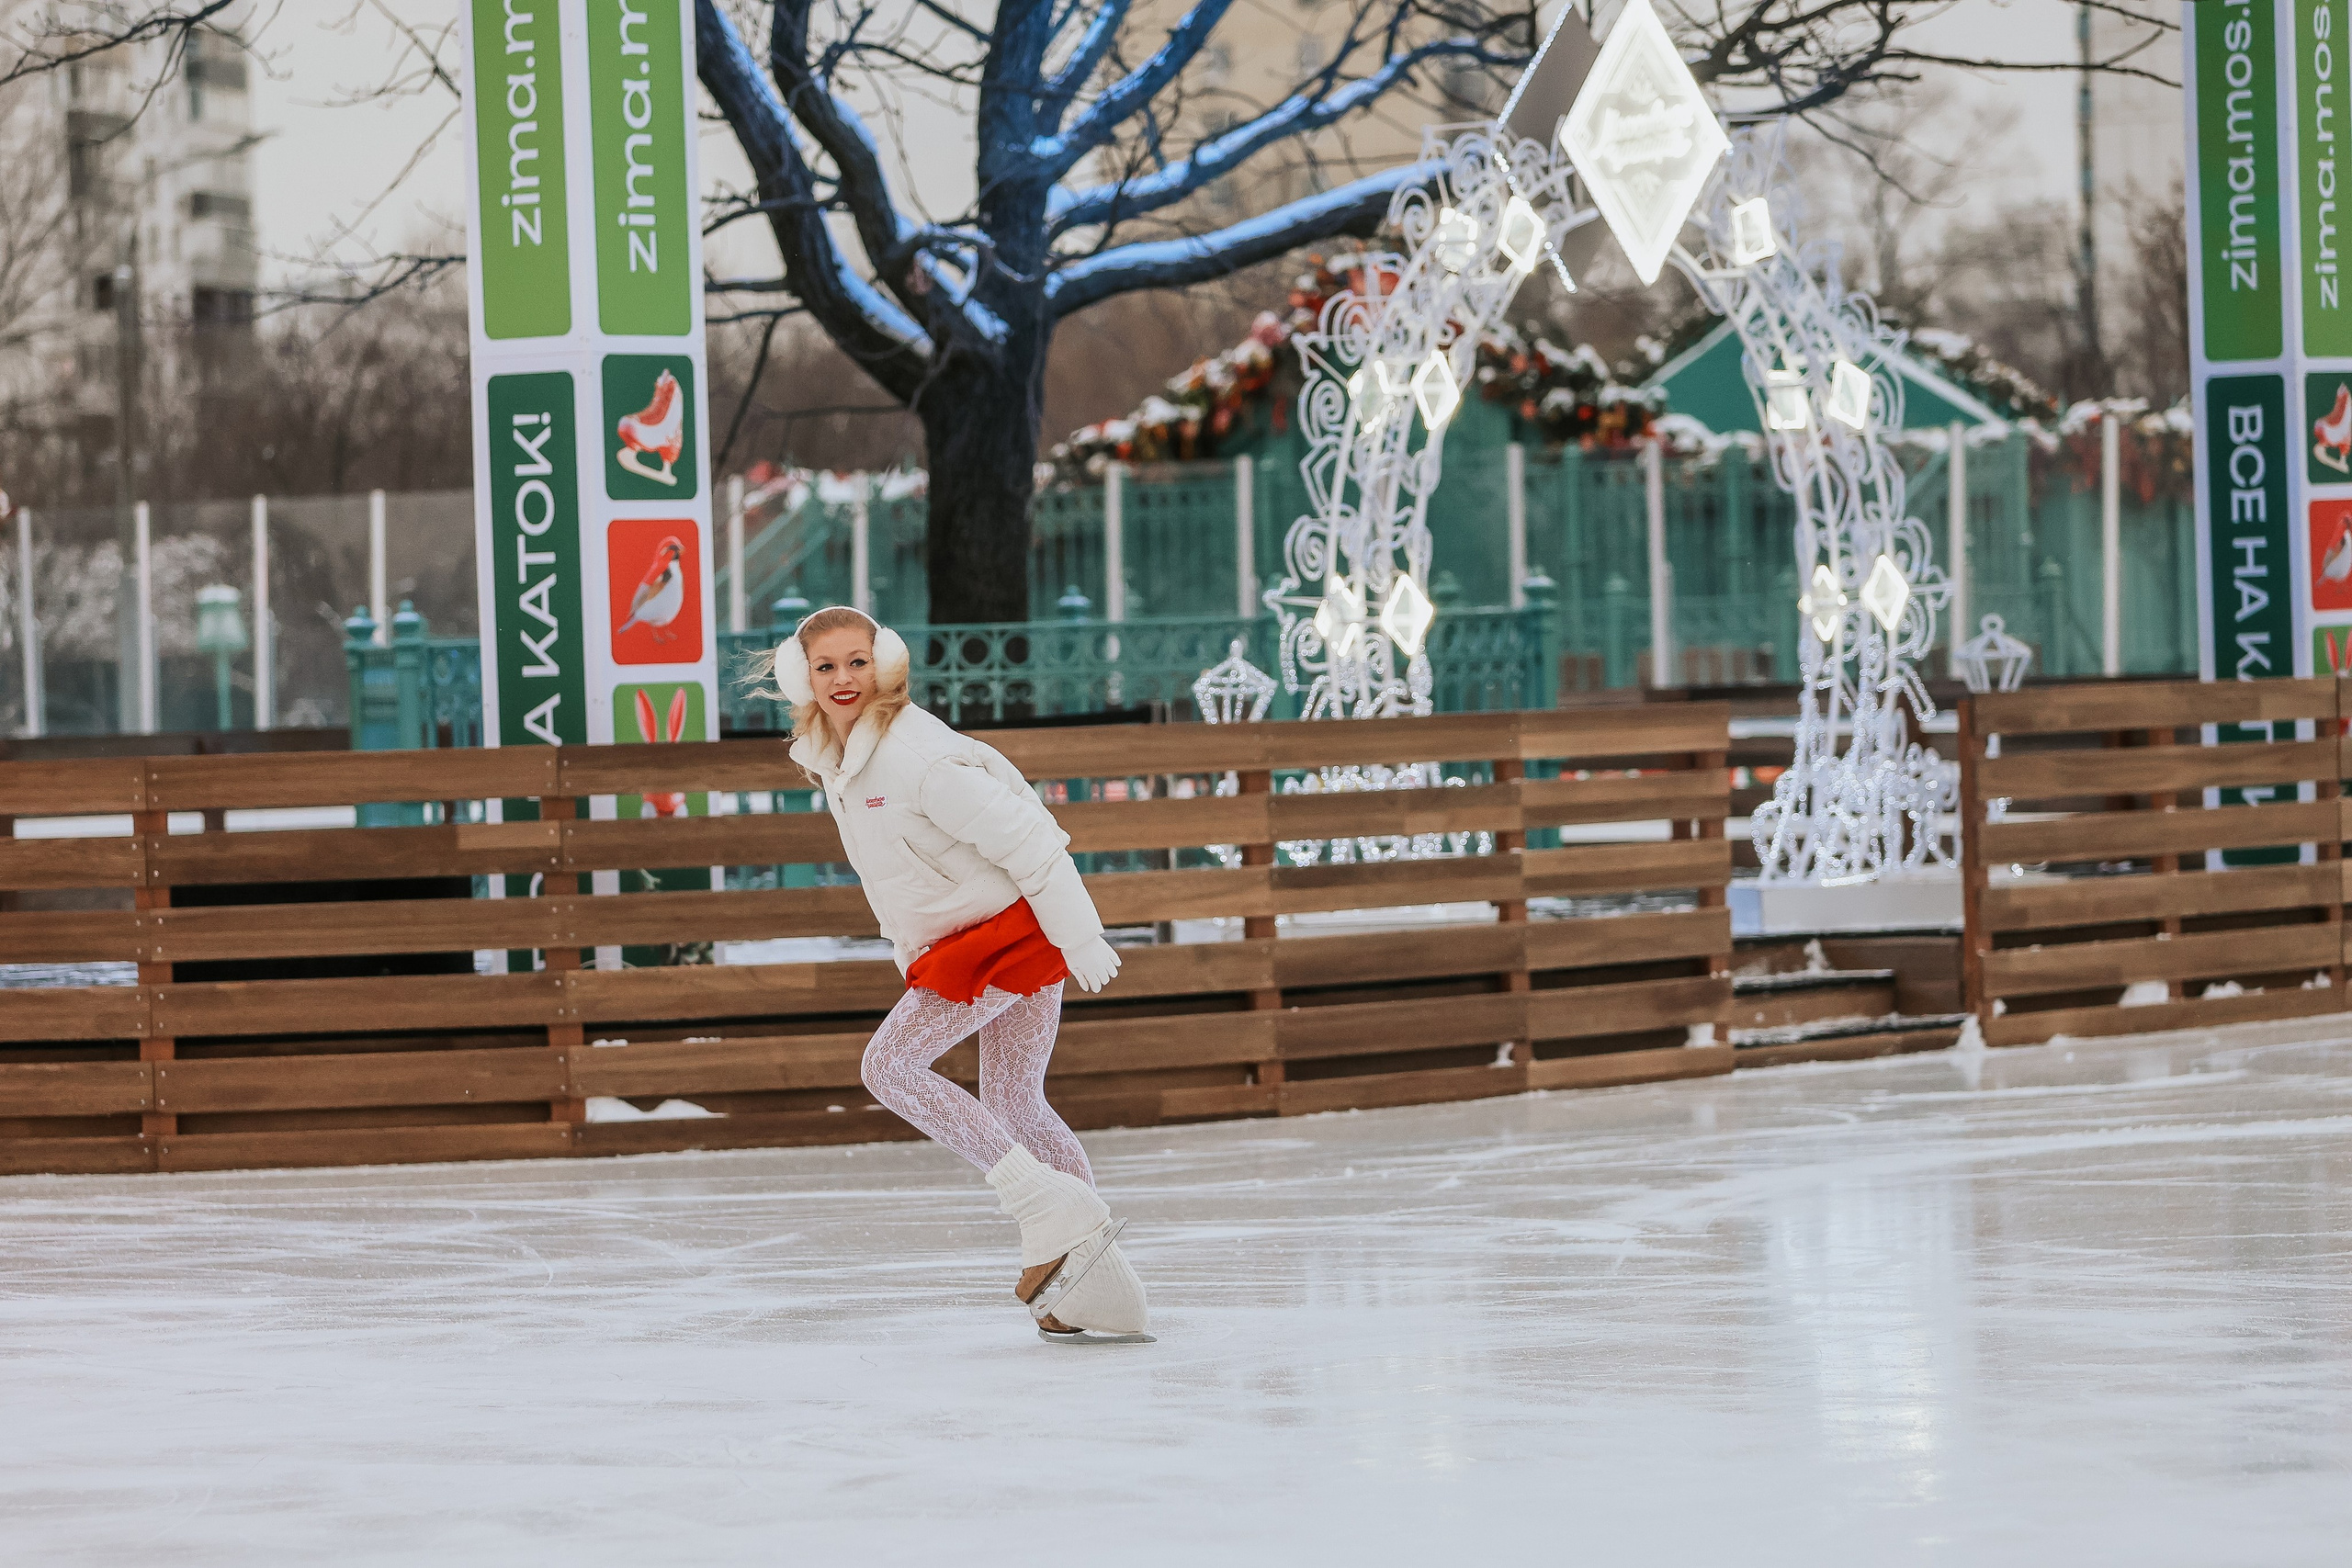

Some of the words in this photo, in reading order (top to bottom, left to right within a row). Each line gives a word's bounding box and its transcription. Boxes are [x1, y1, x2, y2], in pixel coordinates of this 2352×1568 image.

[2221, 0, 2258, 291] zima.mos.
[511, 411, 561, 678] КАТОК!
[2227, 403, 2267, 524] ВСЕ
[2232, 536, 2269, 623] НА
